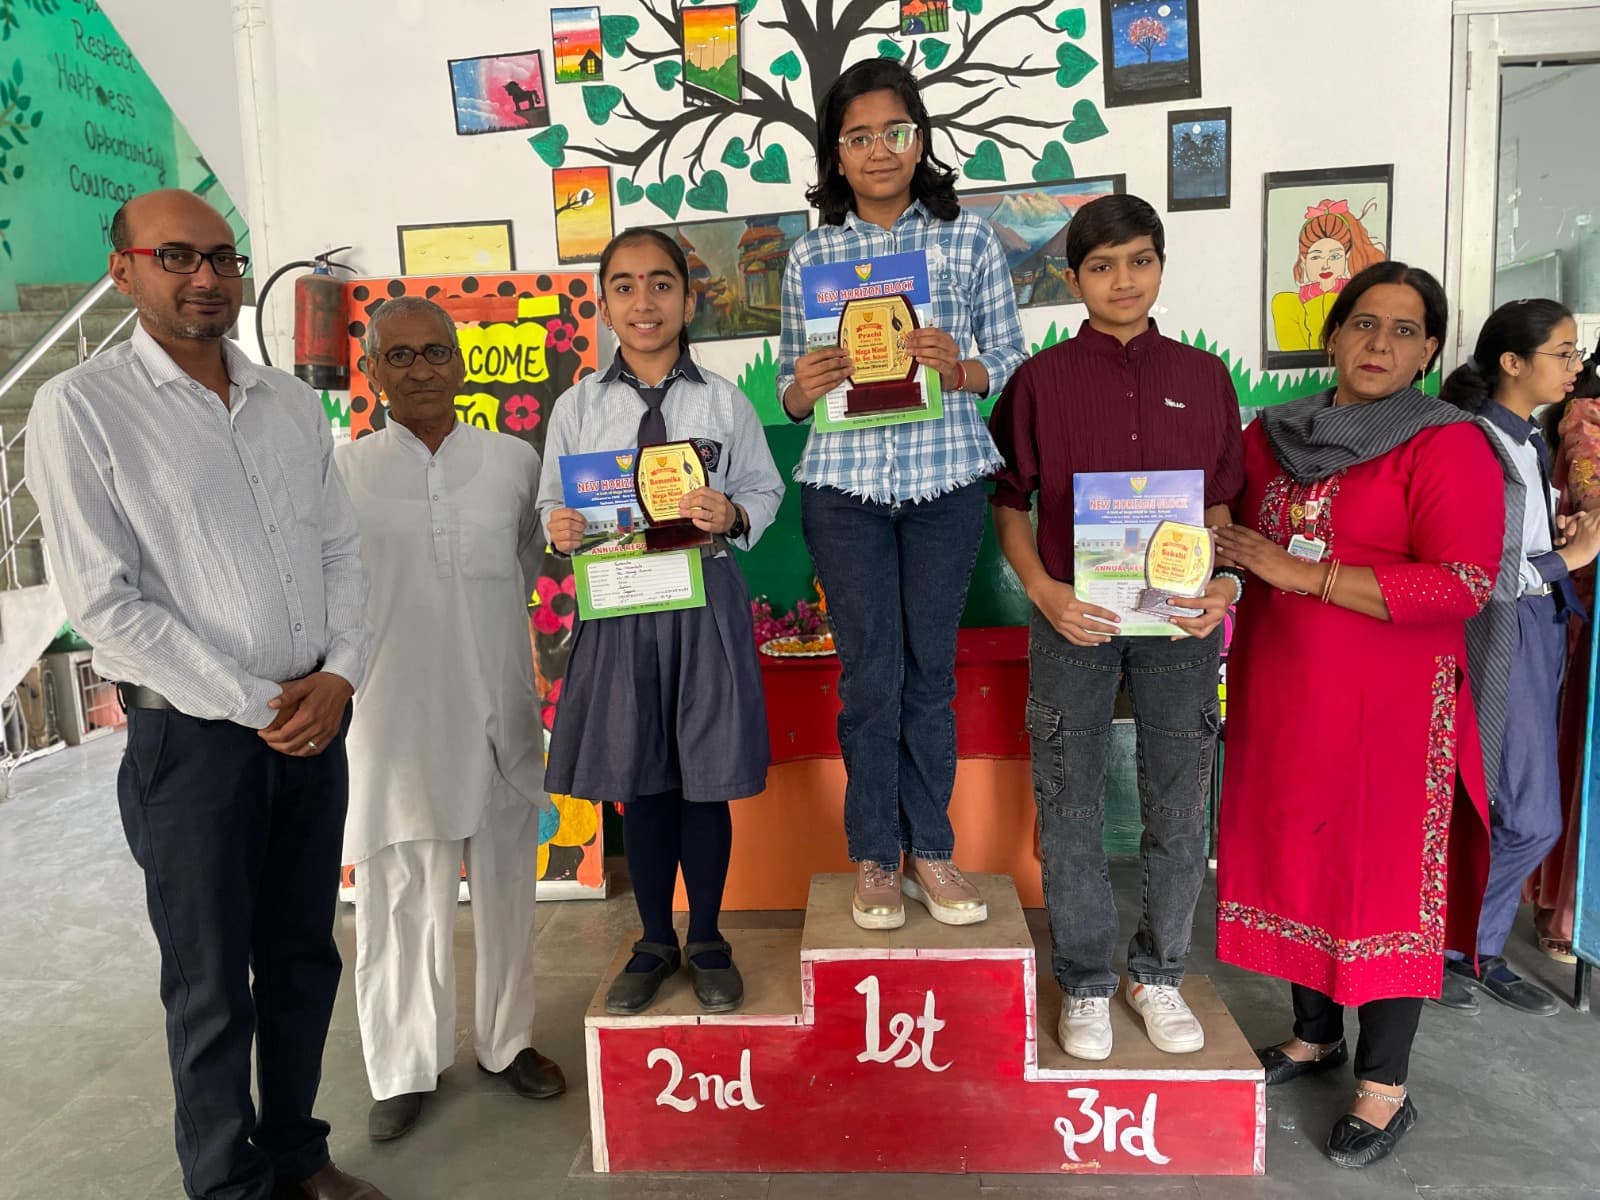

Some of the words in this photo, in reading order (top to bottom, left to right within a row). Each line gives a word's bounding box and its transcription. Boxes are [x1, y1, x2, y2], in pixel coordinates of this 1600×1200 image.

[71, 18, 136, 74] Respect
[55, 52, 136, 119] Happess
[85, 120, 166, 186] Opportunity
[816, 289, 839, 304] NEW
[840, 284, 883, 300] HORIZON
[884, 279, 915, 294] BLOCK
[858, 331, 882, 339] Prachi
[468, 343, 545, 379] COME
[577, 480, 600, 493] NEW
[600, 476, 635, 490] HORIZO
[1089, 498, 1111, 510] NEW
[591, 544, 622, 555] ANNUAL
[1094, 564, 1126, 572] ANNUAL
[855, 976, 950, 1071] 1st
[648, 1048, 763, 1112] 2nd
[1053, 1088, 1172, 1165] 3rd
